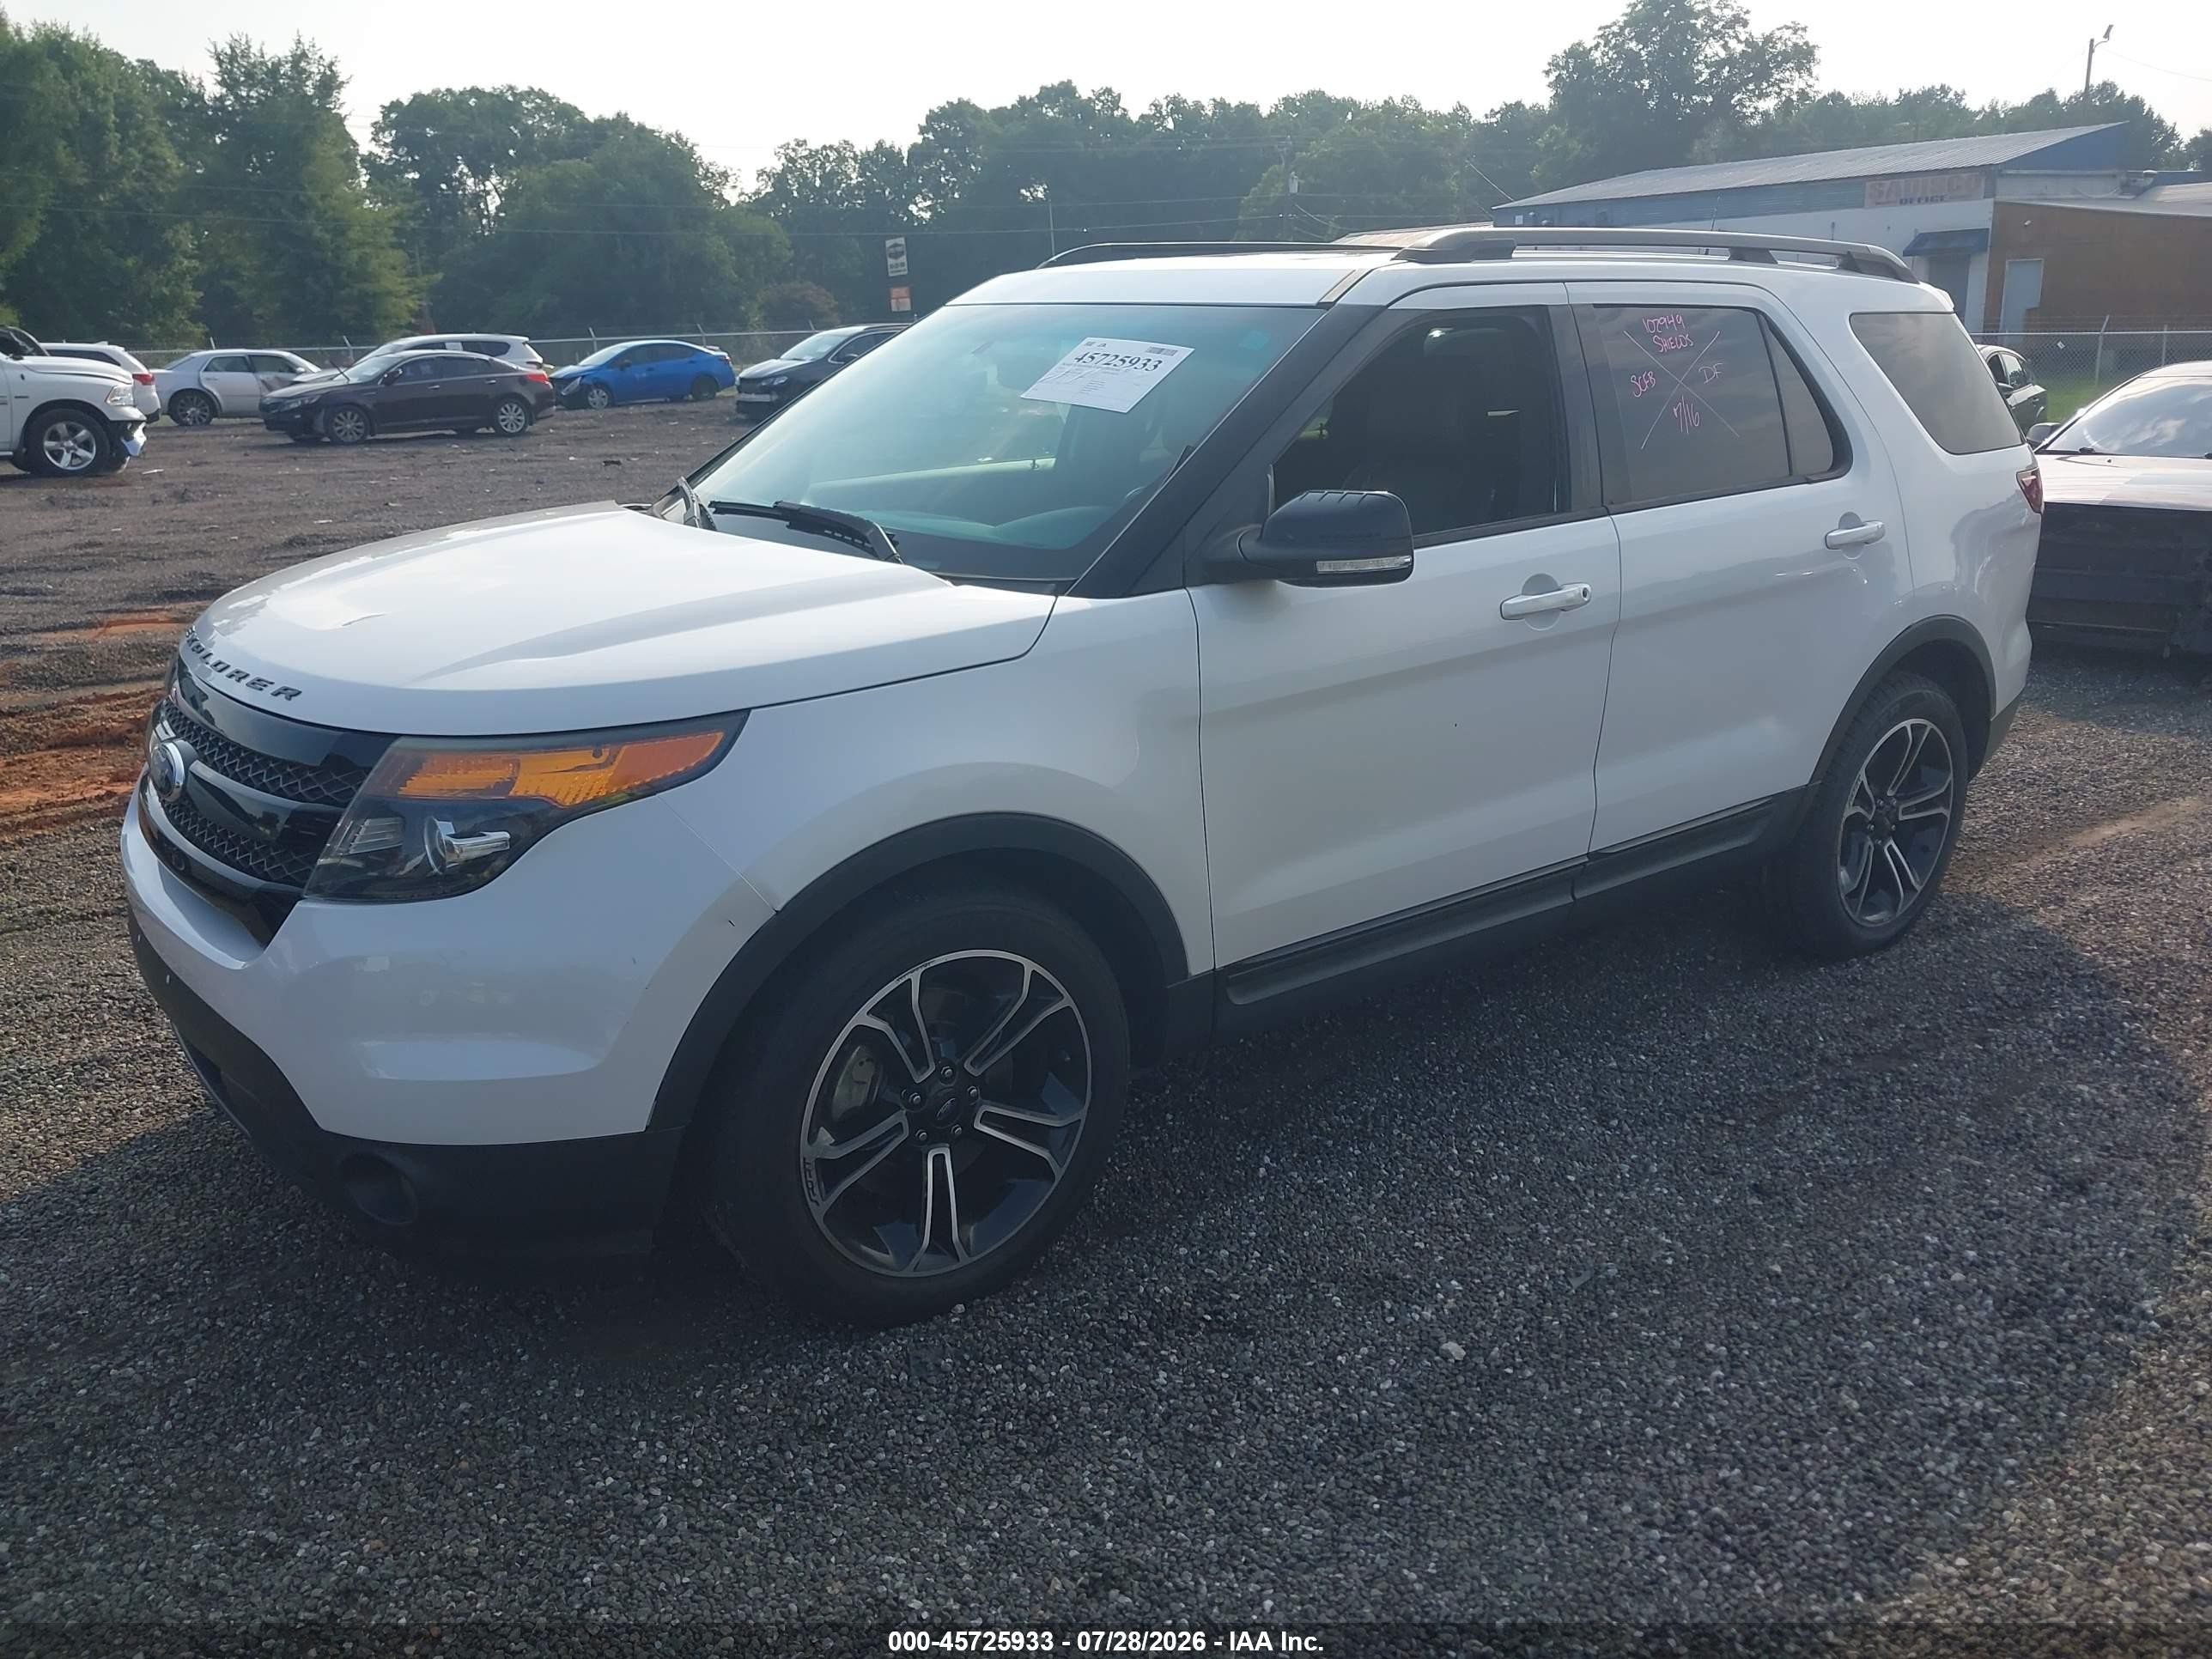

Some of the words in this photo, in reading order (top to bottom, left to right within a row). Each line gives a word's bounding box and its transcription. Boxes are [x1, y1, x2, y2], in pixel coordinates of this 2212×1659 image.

[1899, 194, 1948, 205] OFFICE
[1074, 351, 1163, 372] 45725933
[1674, 394, 1700, 434] 7/16
